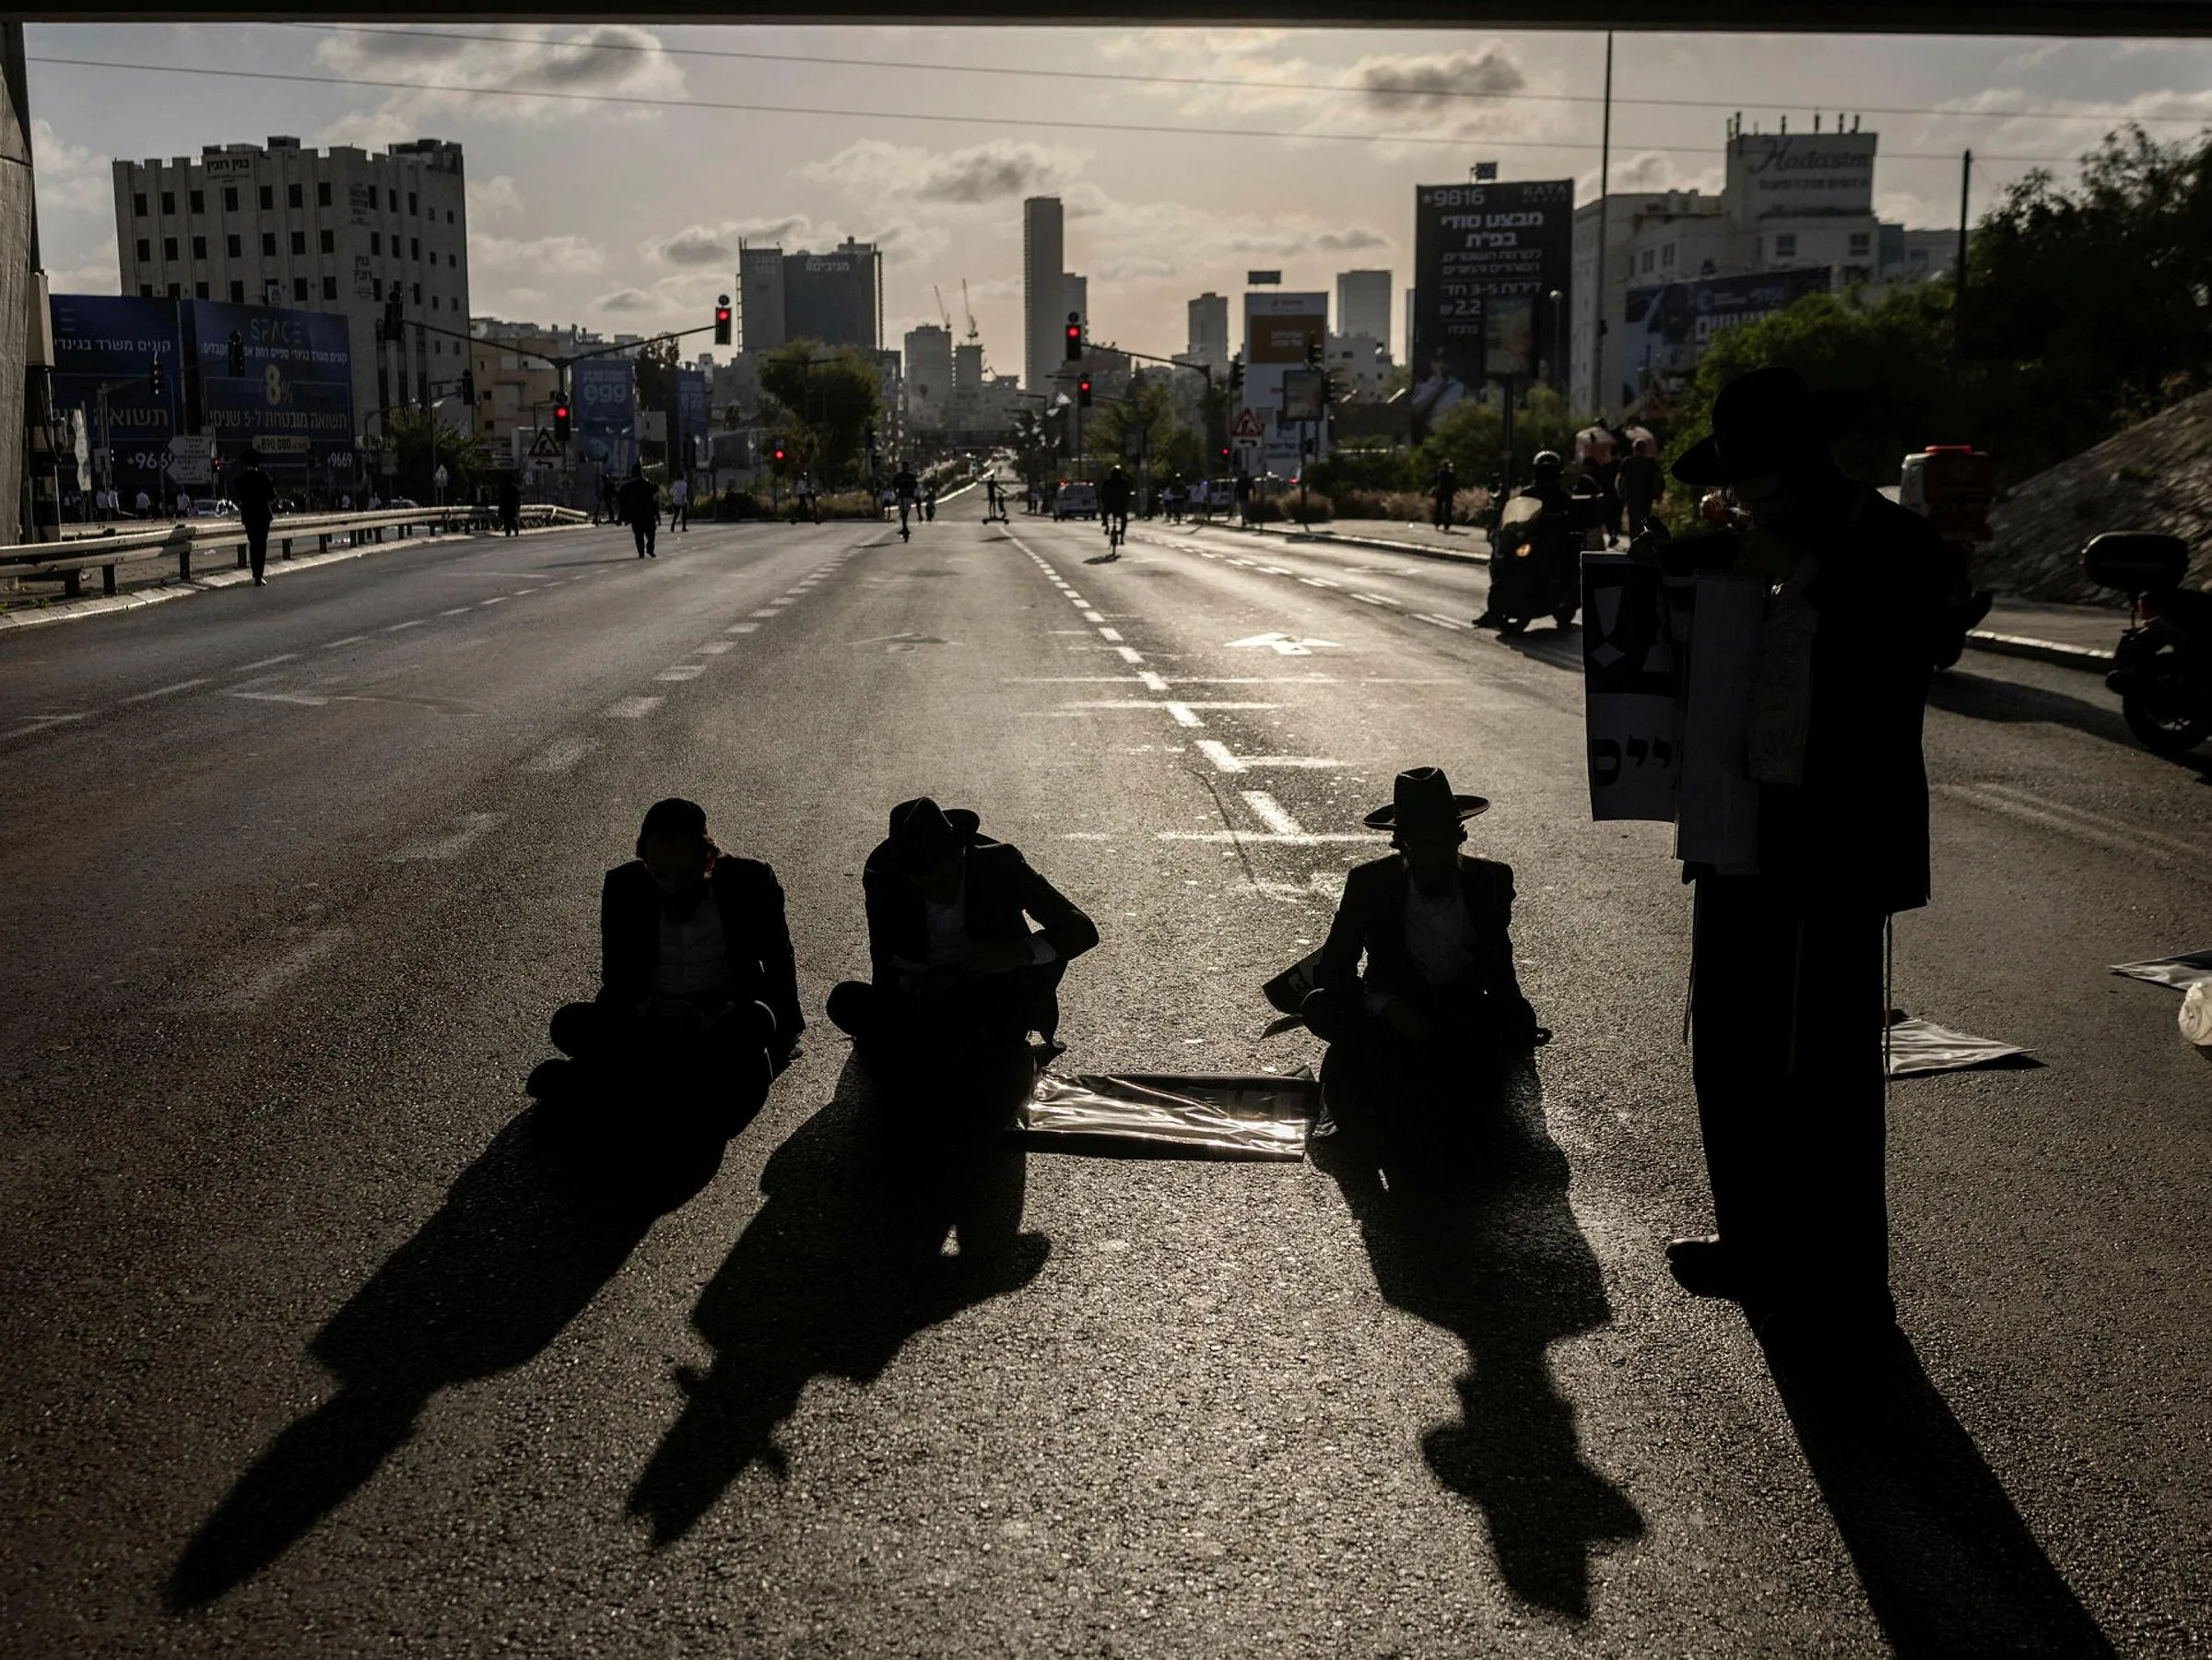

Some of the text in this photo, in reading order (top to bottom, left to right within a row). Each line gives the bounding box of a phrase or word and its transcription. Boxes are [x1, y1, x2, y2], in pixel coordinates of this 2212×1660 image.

[1485, 211, 1545, 228] מבצע
[250, 318, 302, 345] SPACE
[54, 338, 171, 353] קונים משרד בגינדי
[311, 412, 347, 430] תשואה
